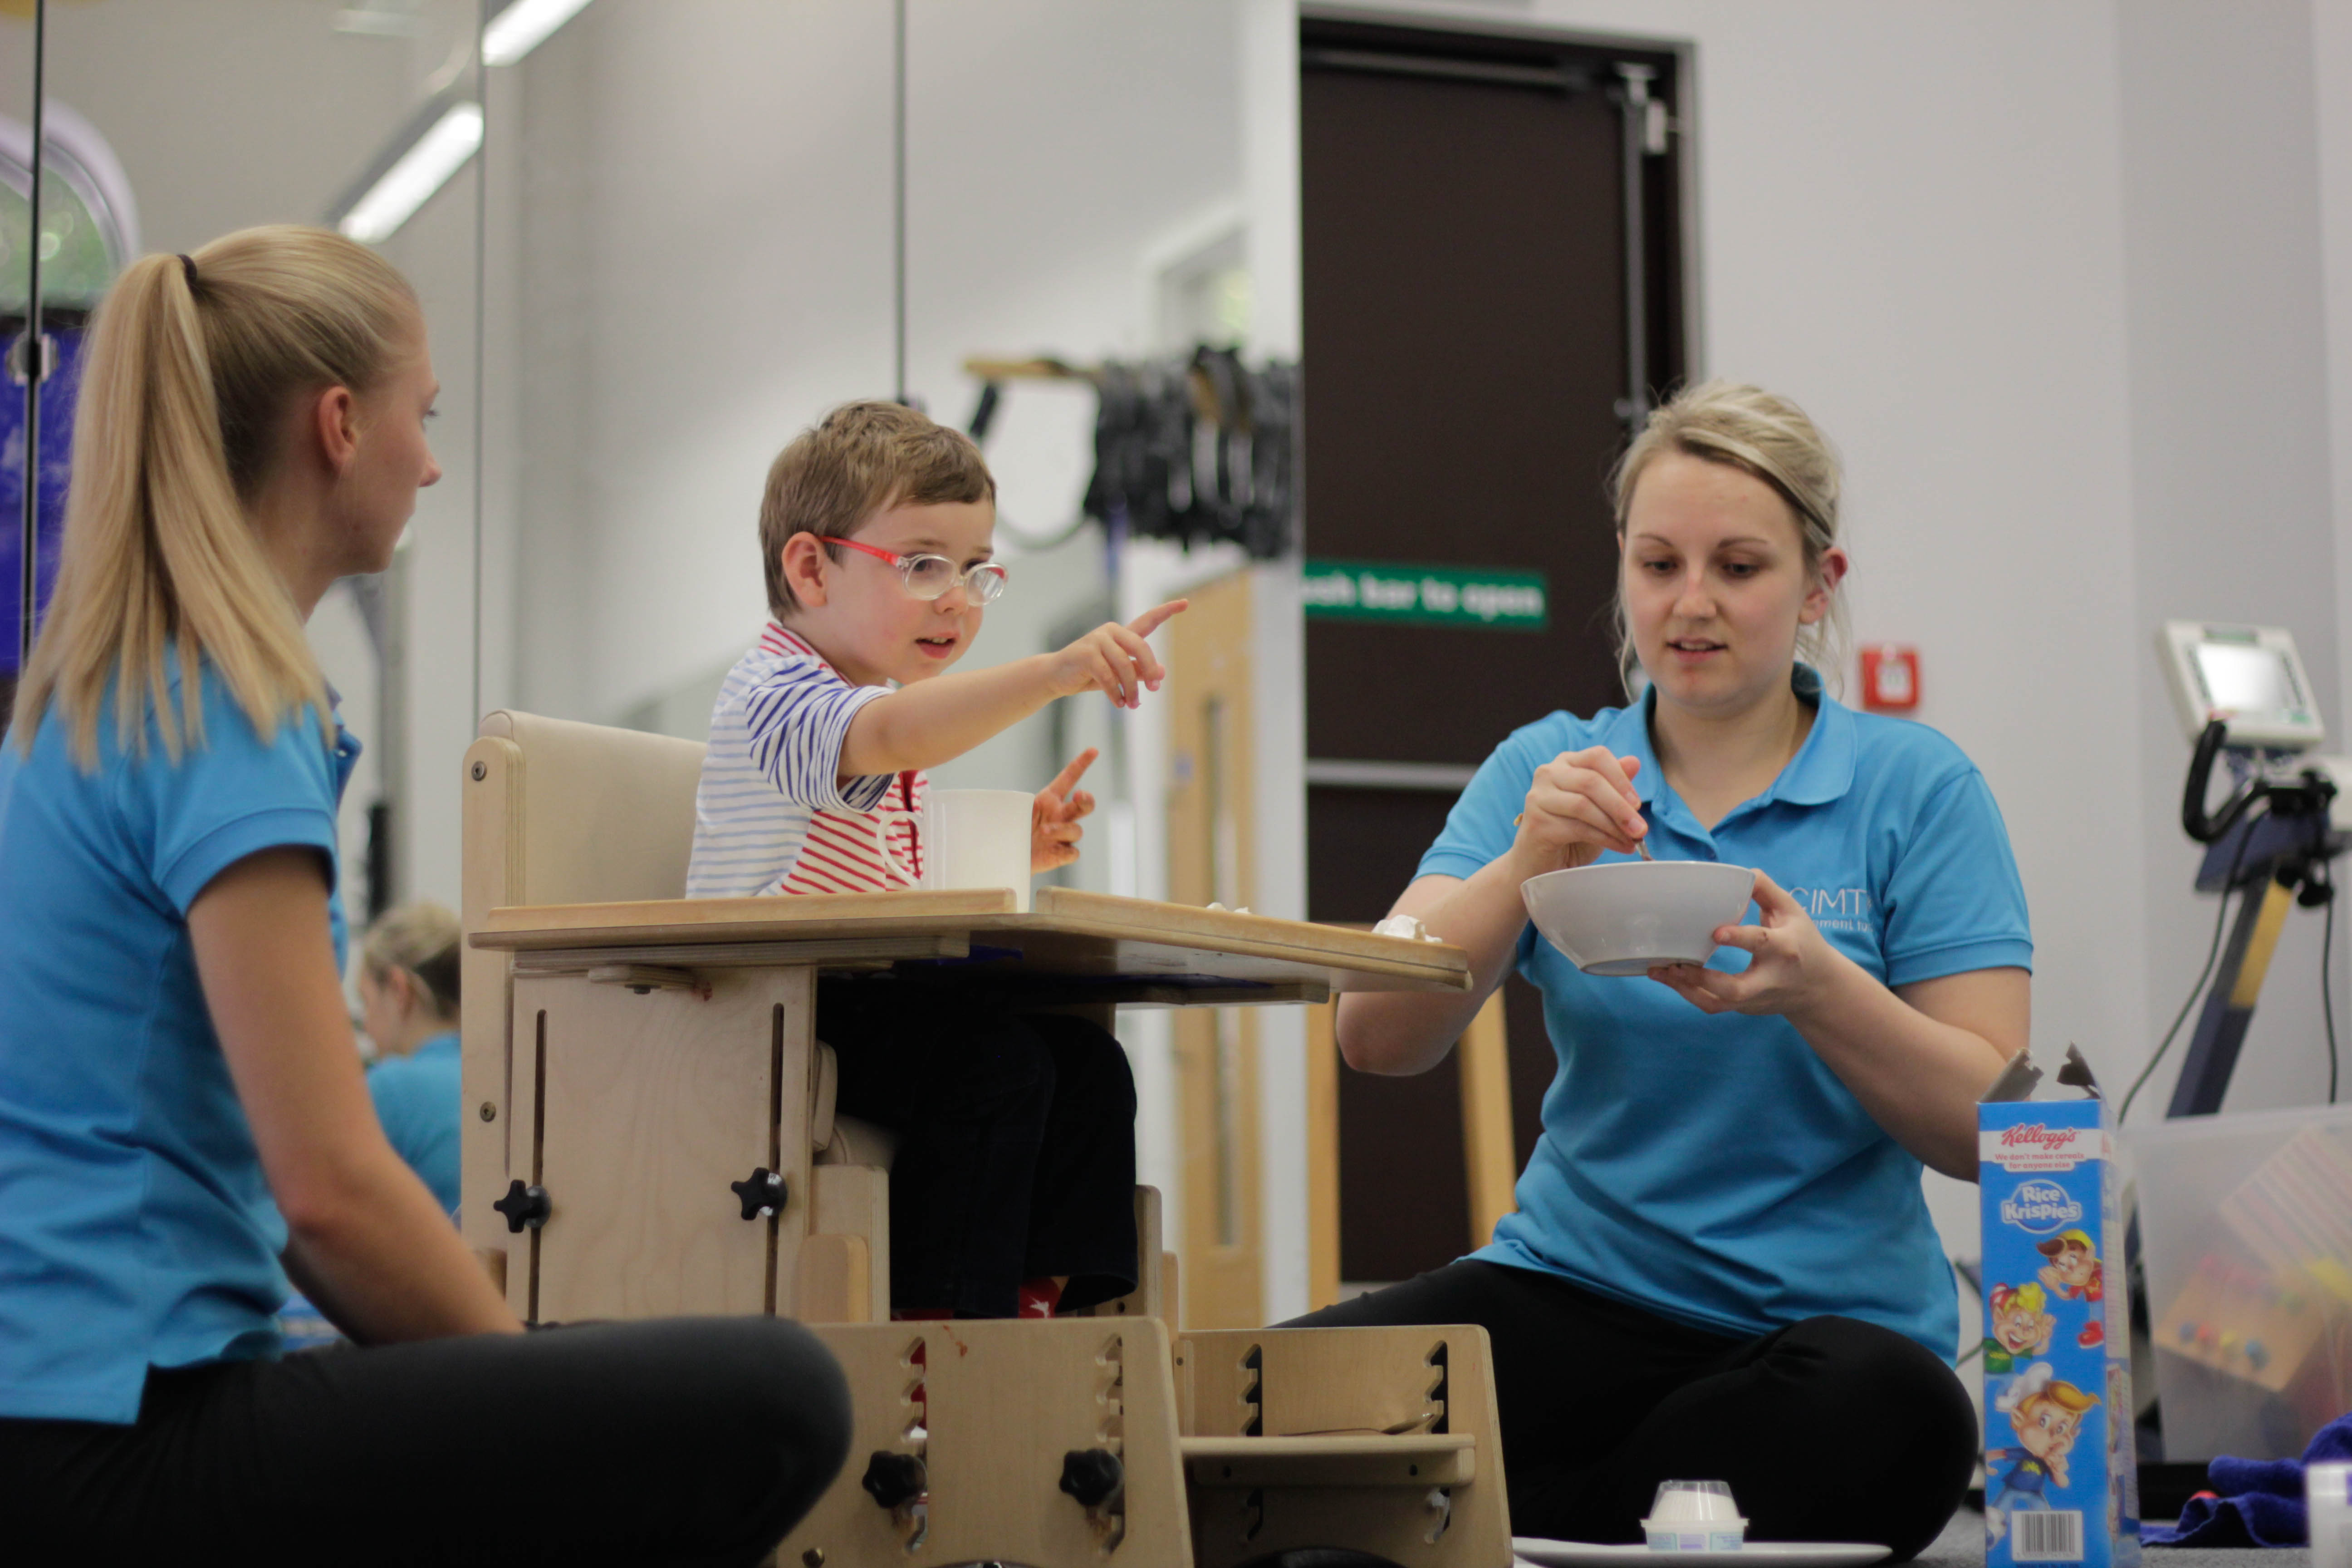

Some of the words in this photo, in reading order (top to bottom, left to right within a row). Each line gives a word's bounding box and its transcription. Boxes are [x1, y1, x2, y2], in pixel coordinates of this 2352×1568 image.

[1359, 574, 1417, 610] bar
[1421, 578, 1458, 613] to
[1461, 584, 1544, 622] open
[1813, 919, 1854, 930] ment
[2001, 1124, 2076, 1150] Kellogg's
[2022, 1186, 2061, 1202] Rice
[2004, 1203, 2078, 1220] Krispies
